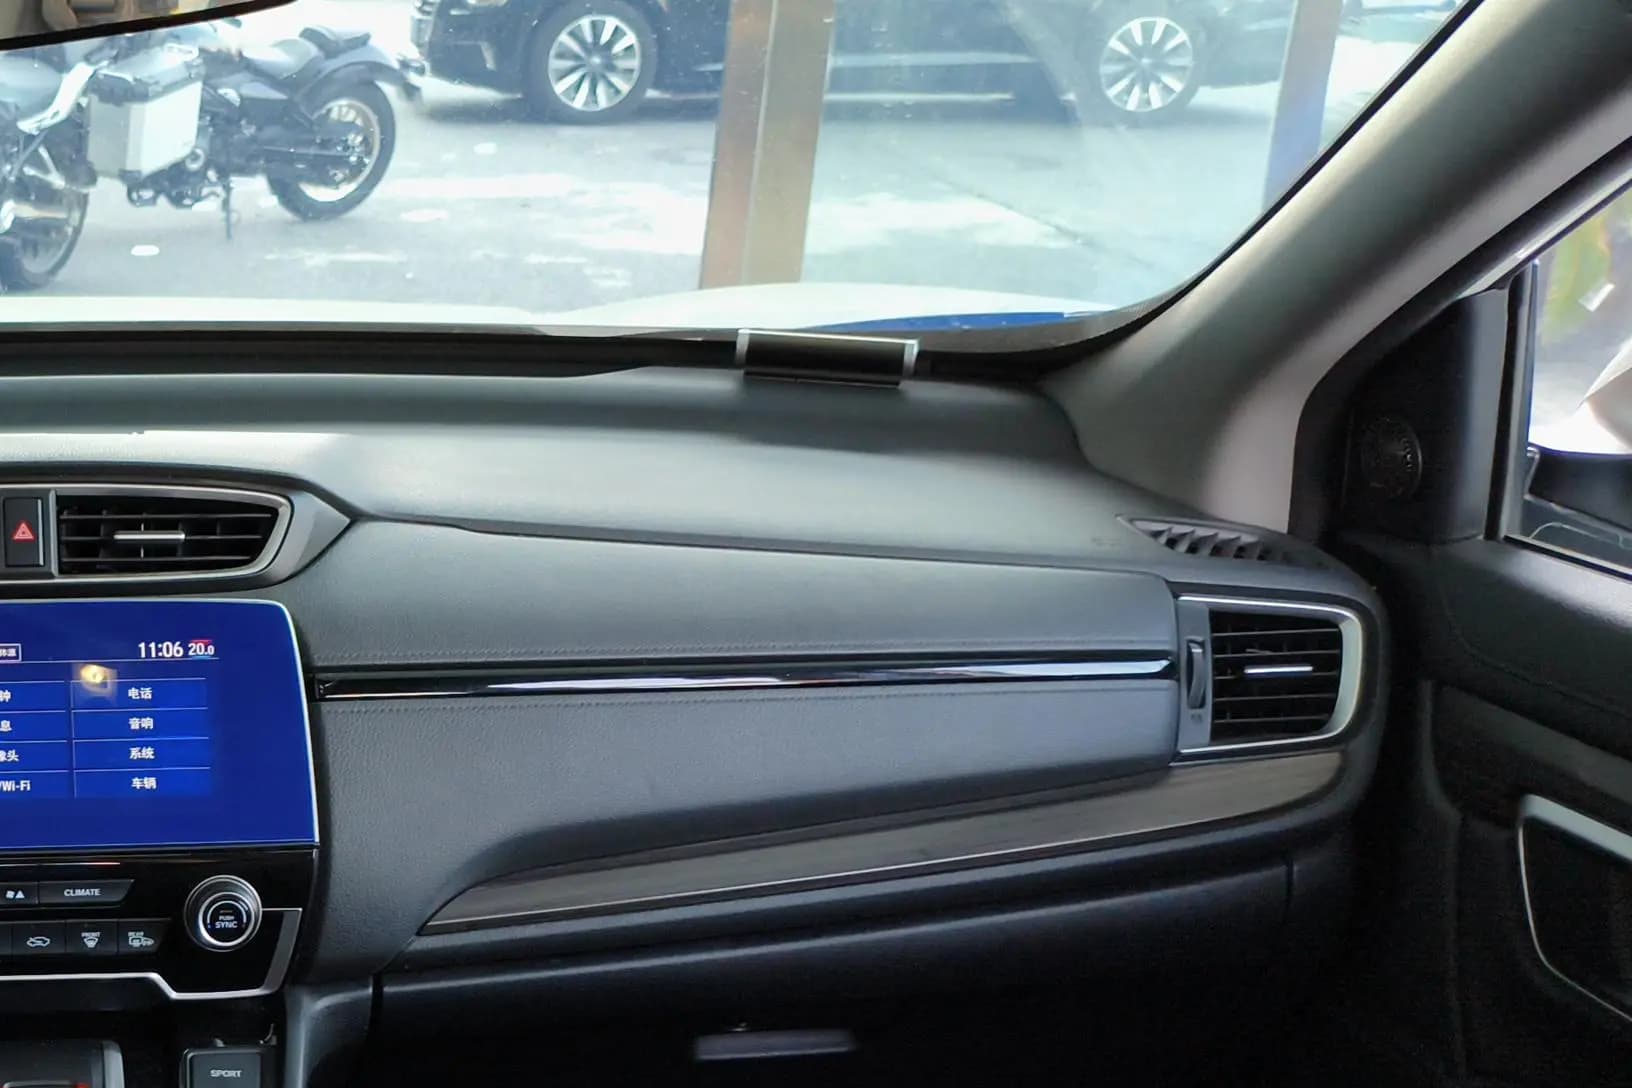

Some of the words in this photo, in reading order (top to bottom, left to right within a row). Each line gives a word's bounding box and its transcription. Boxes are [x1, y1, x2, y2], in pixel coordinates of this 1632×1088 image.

[138, 641, 184, 659] 11:06
[188, 642, 215, 656] 20.0
[127, 687, 153, 700] 电话
[128, 717, 154, 730] 音响
[129, 746, 155, 760] 系统
[131, 777, 157, 790] 车辆
[64, 888, 101, 897] CLIMATE
[215, 920, 239, 929] SYNC
[209, 1069, 243, 1078] SPORT
